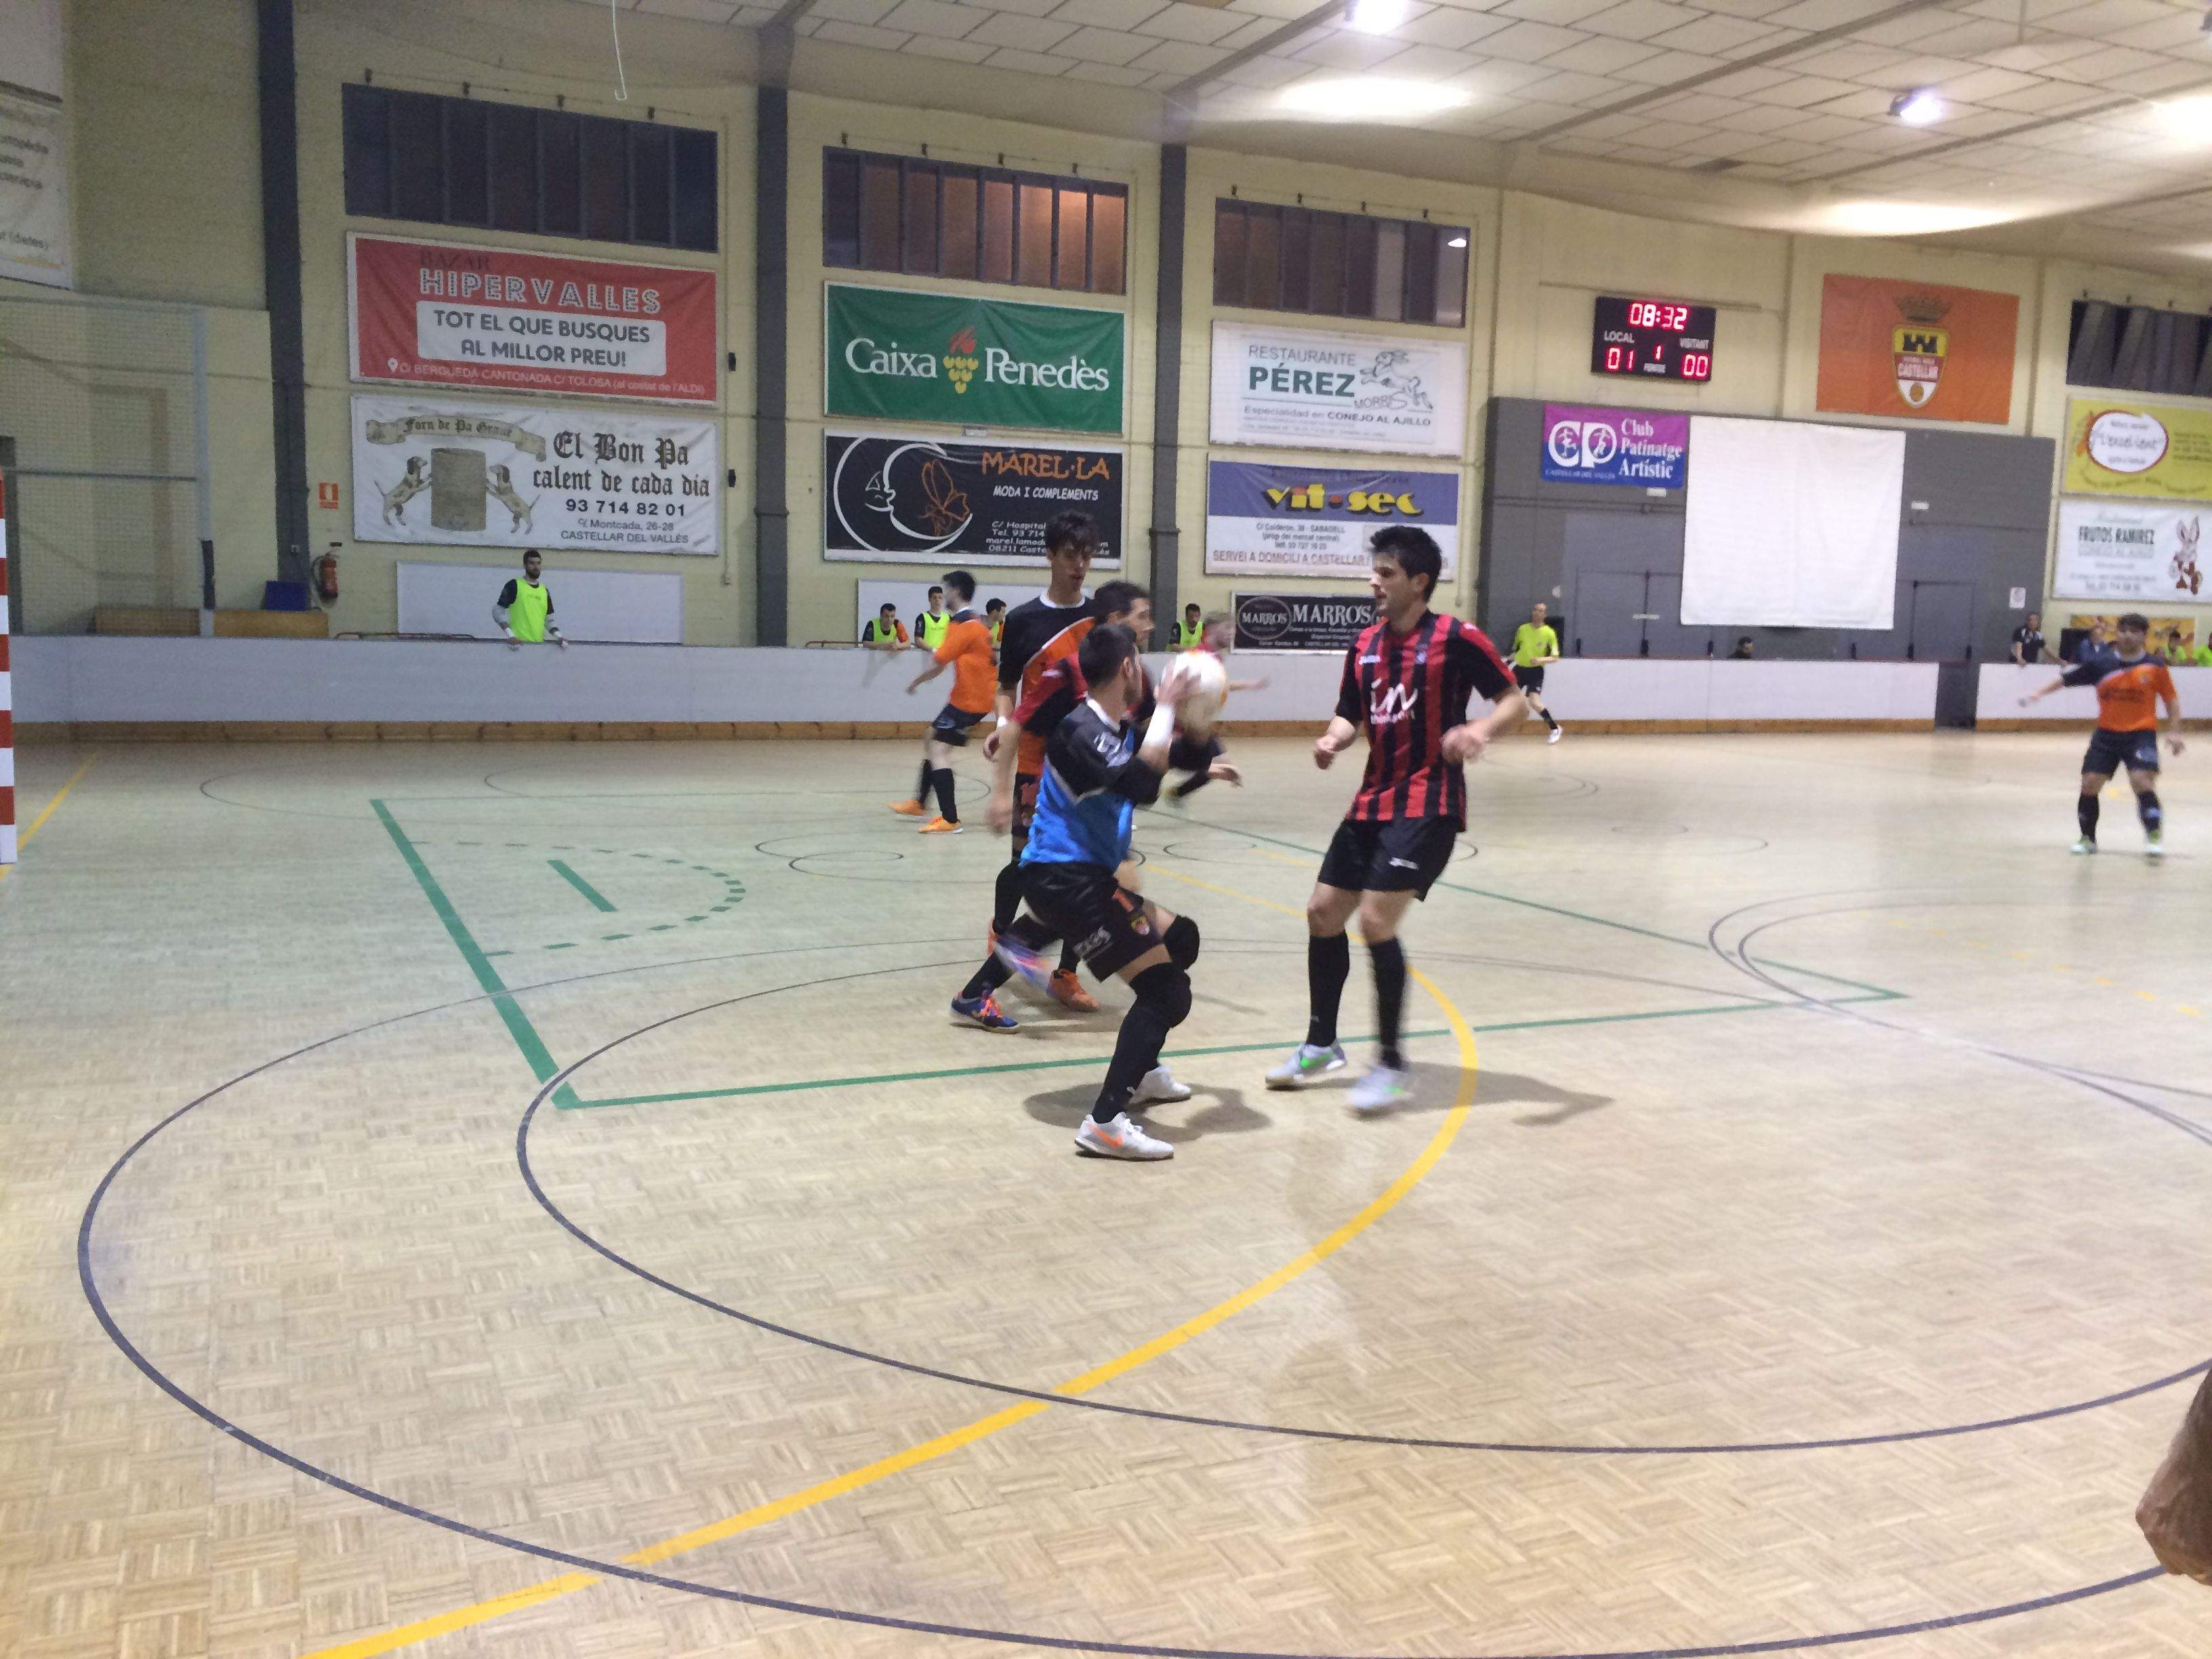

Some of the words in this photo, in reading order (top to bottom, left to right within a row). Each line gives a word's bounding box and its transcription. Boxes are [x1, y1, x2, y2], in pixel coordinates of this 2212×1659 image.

[419, 251, 490, 270] BAZAR
[419, 268, 661, 314] HIPERVALLES
[434, 310, 475, 329] TOT
[480, 314, 504, 331] EL
[509, 316, 553, 336] QUE
[559, 321, 651, 344] BUSQUES
[1629, 303, 1688, 330] 08:32
[1604, 331, 1635, 344] LOCAL
[462, 340, 486, 356] AL
[491, 342, 565, 363] MILLOR
[571, 348, 627, 368] PREU!
[1248, 345, 1355, 367] RESTAURANTE
[1607, 347, 1634, 369] 01
[1655, 345, 1661, 360] 1
[845, 337, 937, 378] Caixa
[985, 348, 1110, 391] Penedès
[1683, 354, 1708, 377] 00
[568, 375, 610, 388] TOLOSA
[1249, 363, 1355, 397] PÉREZ
[1327, 411, 1373, 423] CONEJO
[1376, 415, 1389, 424] AL
[1621, 417, 1654, 437] Club
[553, 430, 583, 459] El
[594, 432, 644, 464] Bon
[655, 437, 689, 470] Pa
[533, 465, 592, 491] calent
[601, 470, 622, 493] de
[632, 472, 674, 495] cada
[993, 485, 1021, 498] MODA
[1024, 487, 1030, 498] I
[1032, 487, 1099, 501] COMPLEMENTS
[565, 499, 589, 512] 93
[596, 500, 630, 514] 714
[636, 502, 659, 516] 82
[665, 503, 685, 517] 01
[560, 530, 624, 541] CASTELLAR
[626, 533, 647, 543] DEL
[1213, 550, 1247, 562] SERVEI
[1250, 552, 1256, 562] A
[1303, 554, 1308, 563] A
